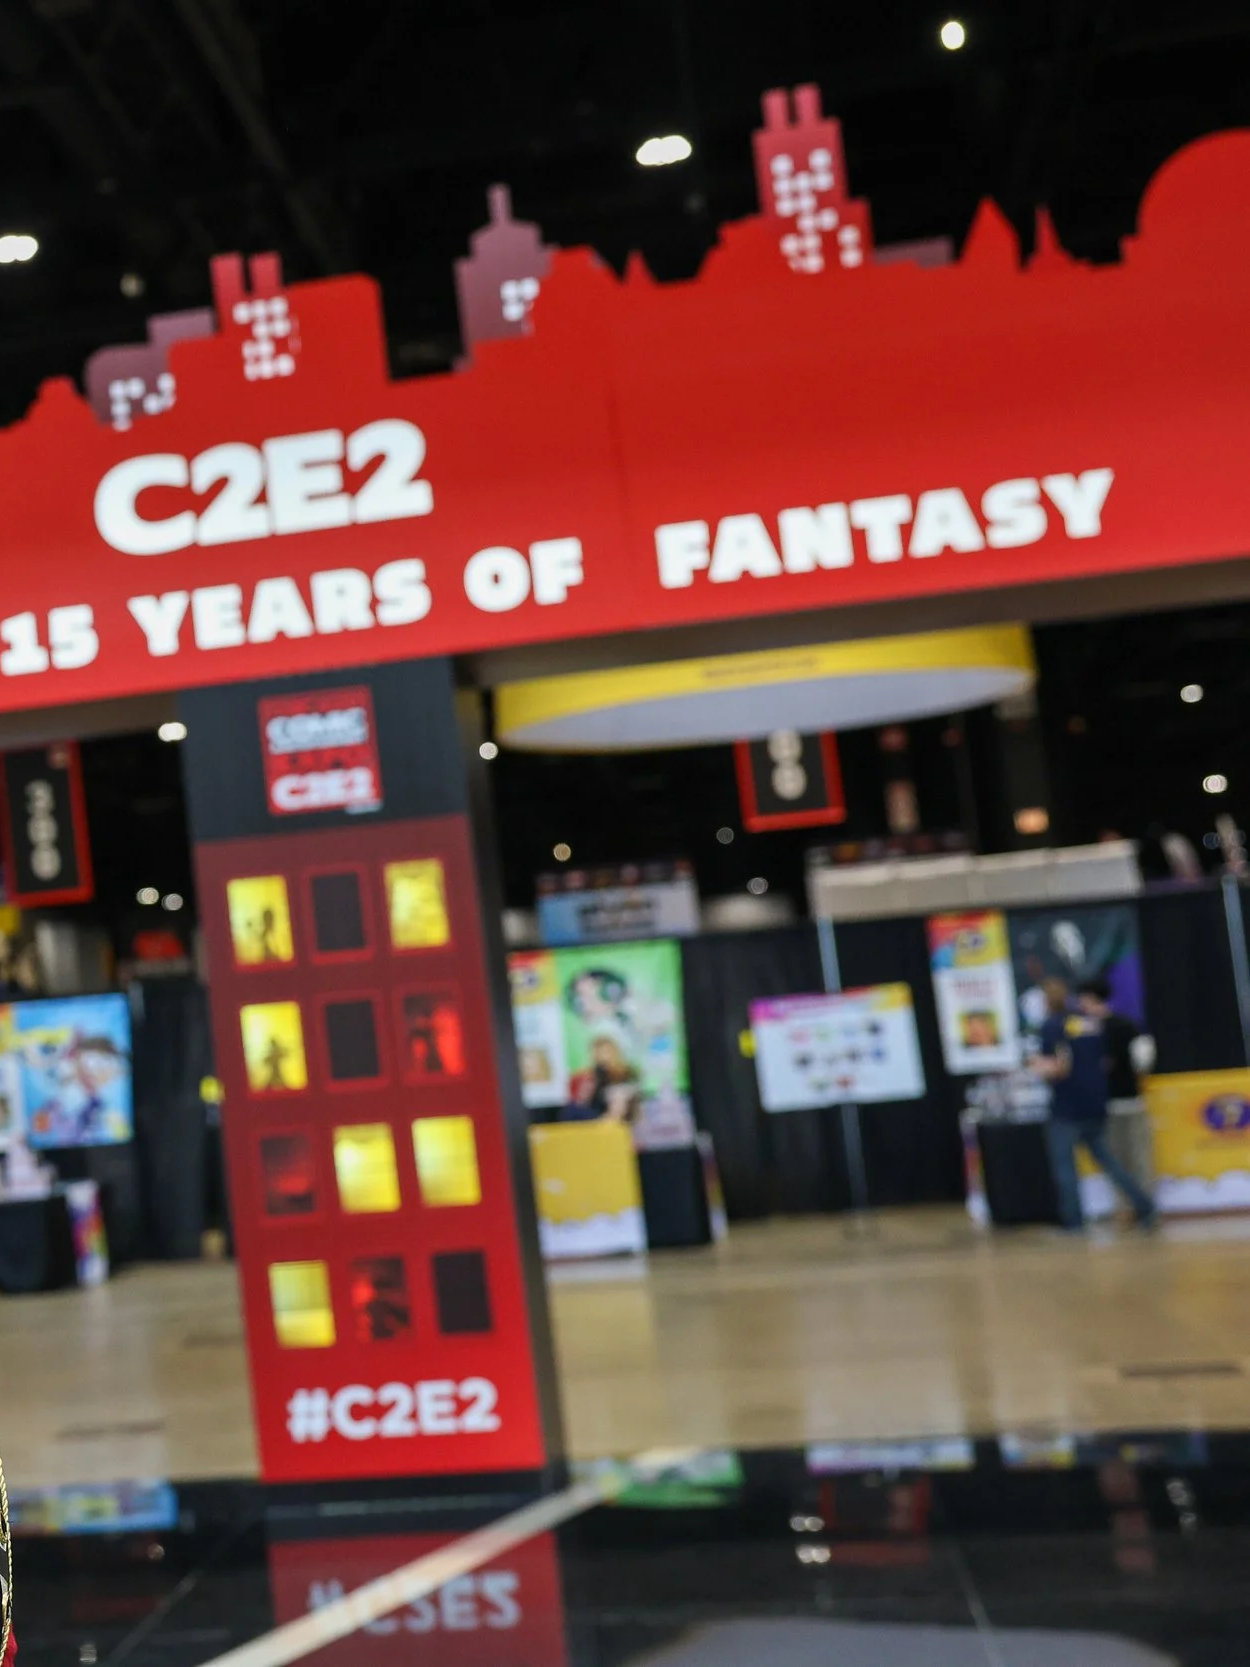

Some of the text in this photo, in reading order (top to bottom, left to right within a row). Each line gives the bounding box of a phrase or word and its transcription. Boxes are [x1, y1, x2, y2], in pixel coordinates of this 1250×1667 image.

[93, 418, 434, 557] C2E2
[126, 557, 433, 658] YEARS
[462, 536, 585, 613] OF
[653, 467, 1115, 590] FANTASY
[287, 1376, 501, 1443] #C2E2
